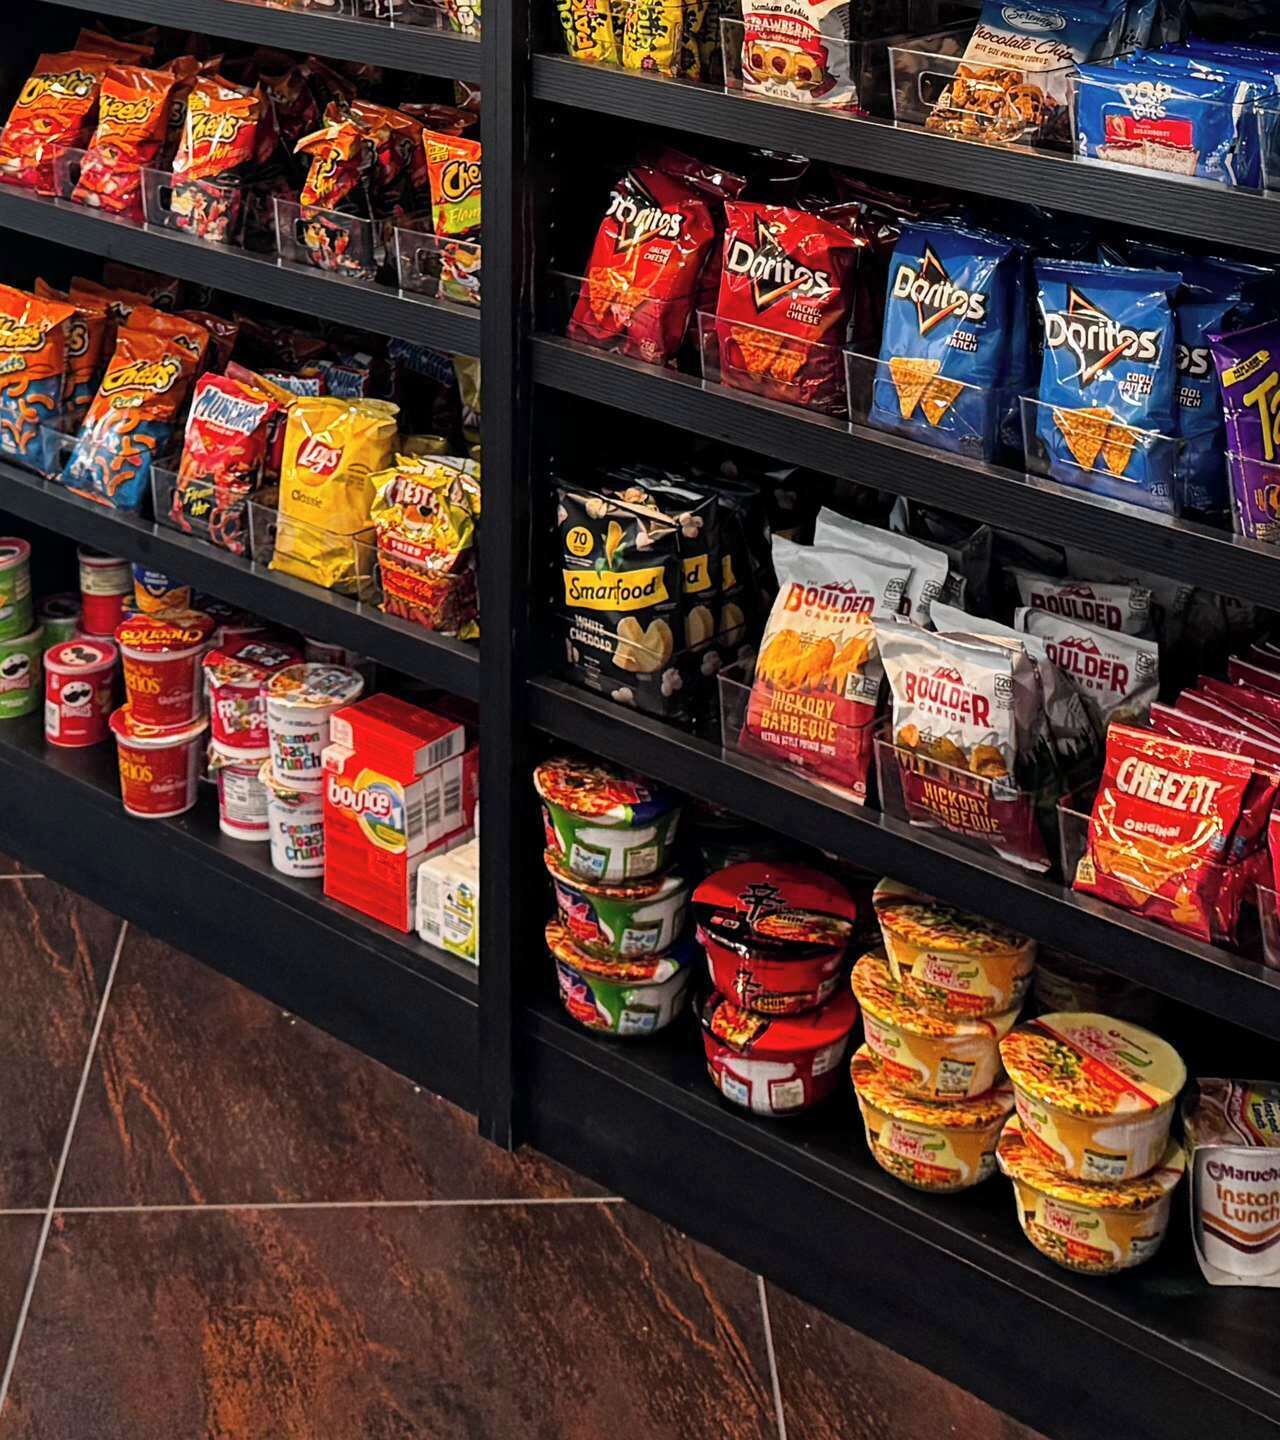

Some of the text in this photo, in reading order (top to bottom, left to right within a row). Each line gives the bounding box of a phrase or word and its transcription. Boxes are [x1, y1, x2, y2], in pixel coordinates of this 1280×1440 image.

[744, 15, 815, 44] STRAWBERRY
[1035, 39, 1075, 64] Chip
[606, 190, 683, 238] Doritos
[727, 241, 831, 293] Doritos
[893, 265, 986, 321] Doritos
[786, 310, 821, 326] CHEESE
[789, 302, 823, 319] NACHO
[946, 338, 979, 354] RANCH
[954, 330, 979, 344] COOL
[1045, 313, 1158, 359] Doritos
[1119, 381, 1153, 397] RANCH
[1126, 372, 1153, 387] COOL
[574, 532, 589, 547] 70
[569, 575, 658, 606] Smartfood
[575, 614, 606, 633] WHITE
[805, 608, 853, 625] CANYON
[570, 627, 614, 655] CHEDDAR
[1045, 642, 1130, 697] OULDER
[771, 691, 837, 721] HICKORY
[905, 670, 992, 729] BOULDER
[760, 711, 839, 743] BARBEQUE
[918, 703, 968, 726] CANYON
[275, 752, 324, 772] Crunch
[279, 741, 313, 758] Toast
[923, 780, 990, 817] HICKORY
